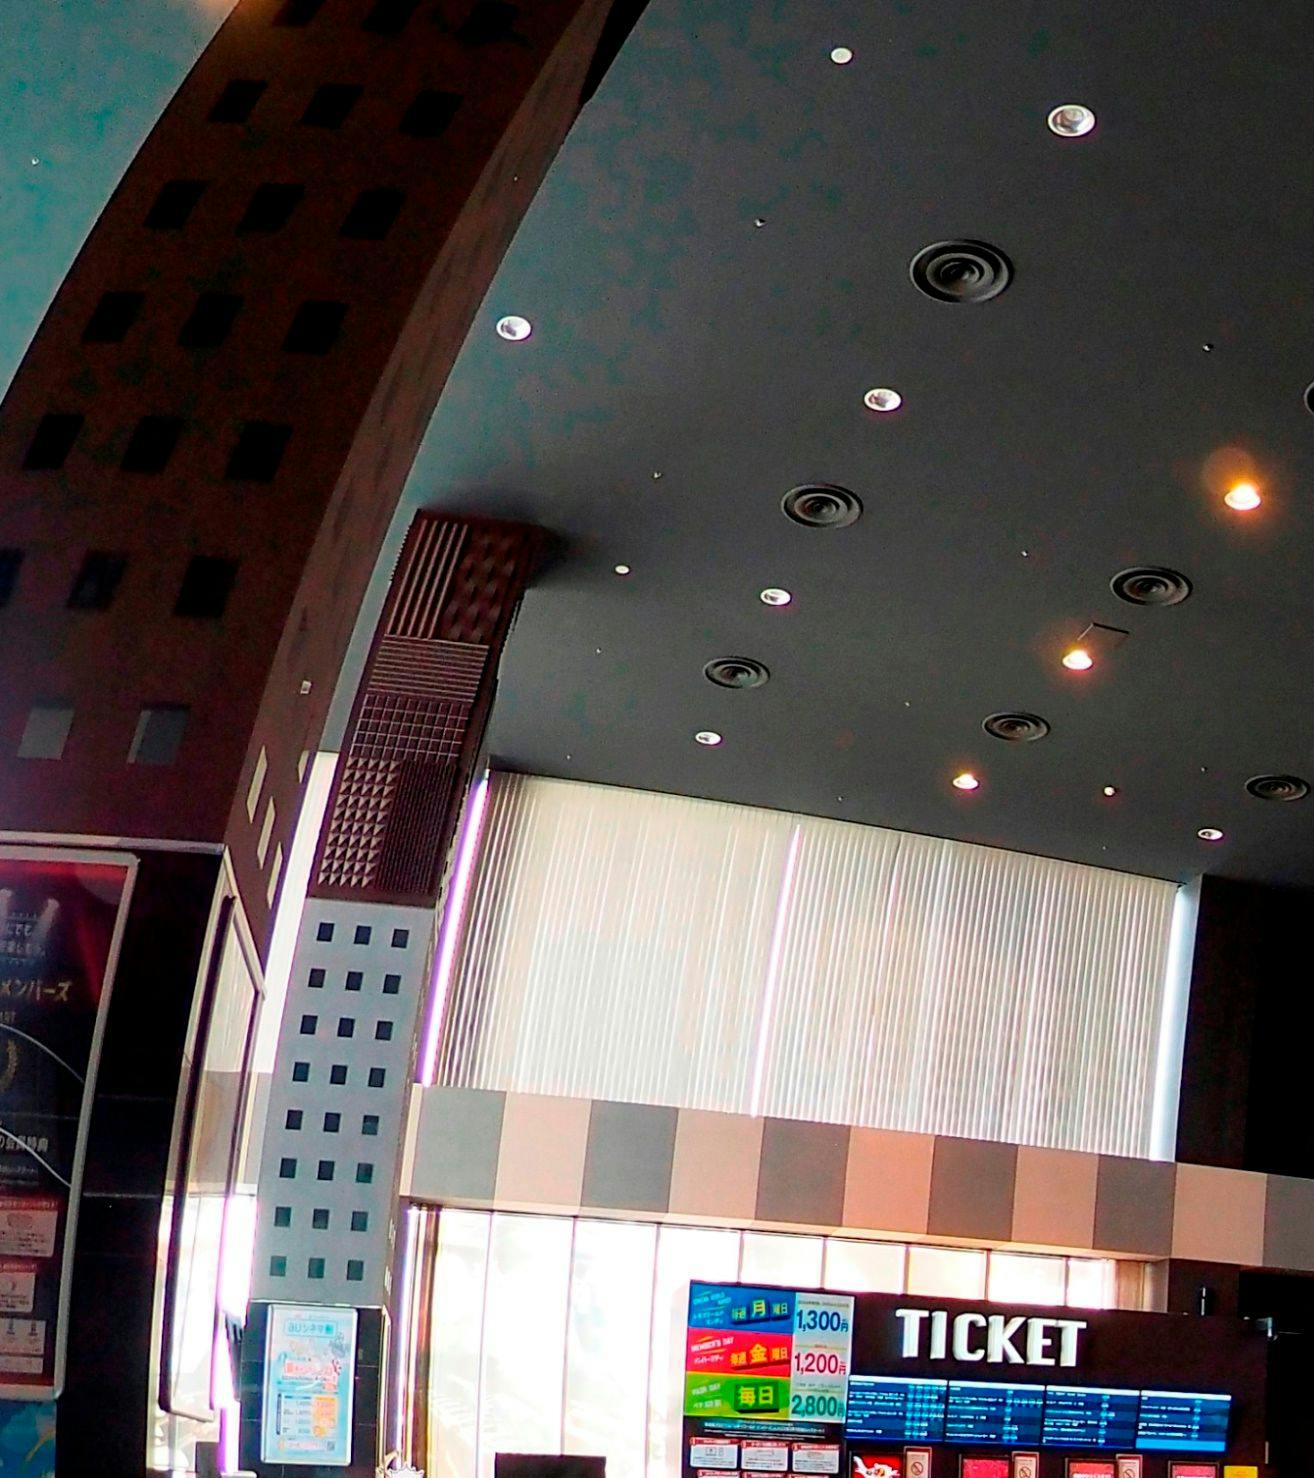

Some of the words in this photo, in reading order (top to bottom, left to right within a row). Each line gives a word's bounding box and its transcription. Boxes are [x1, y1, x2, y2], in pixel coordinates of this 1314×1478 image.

[797, 1309, 849, 1333] 1,300円
[896, 1308, 1087, 1367] TICKET
[794, 1352, 846, 1376] 1,200円
[739, 1385, 774, 1407] 毎日
